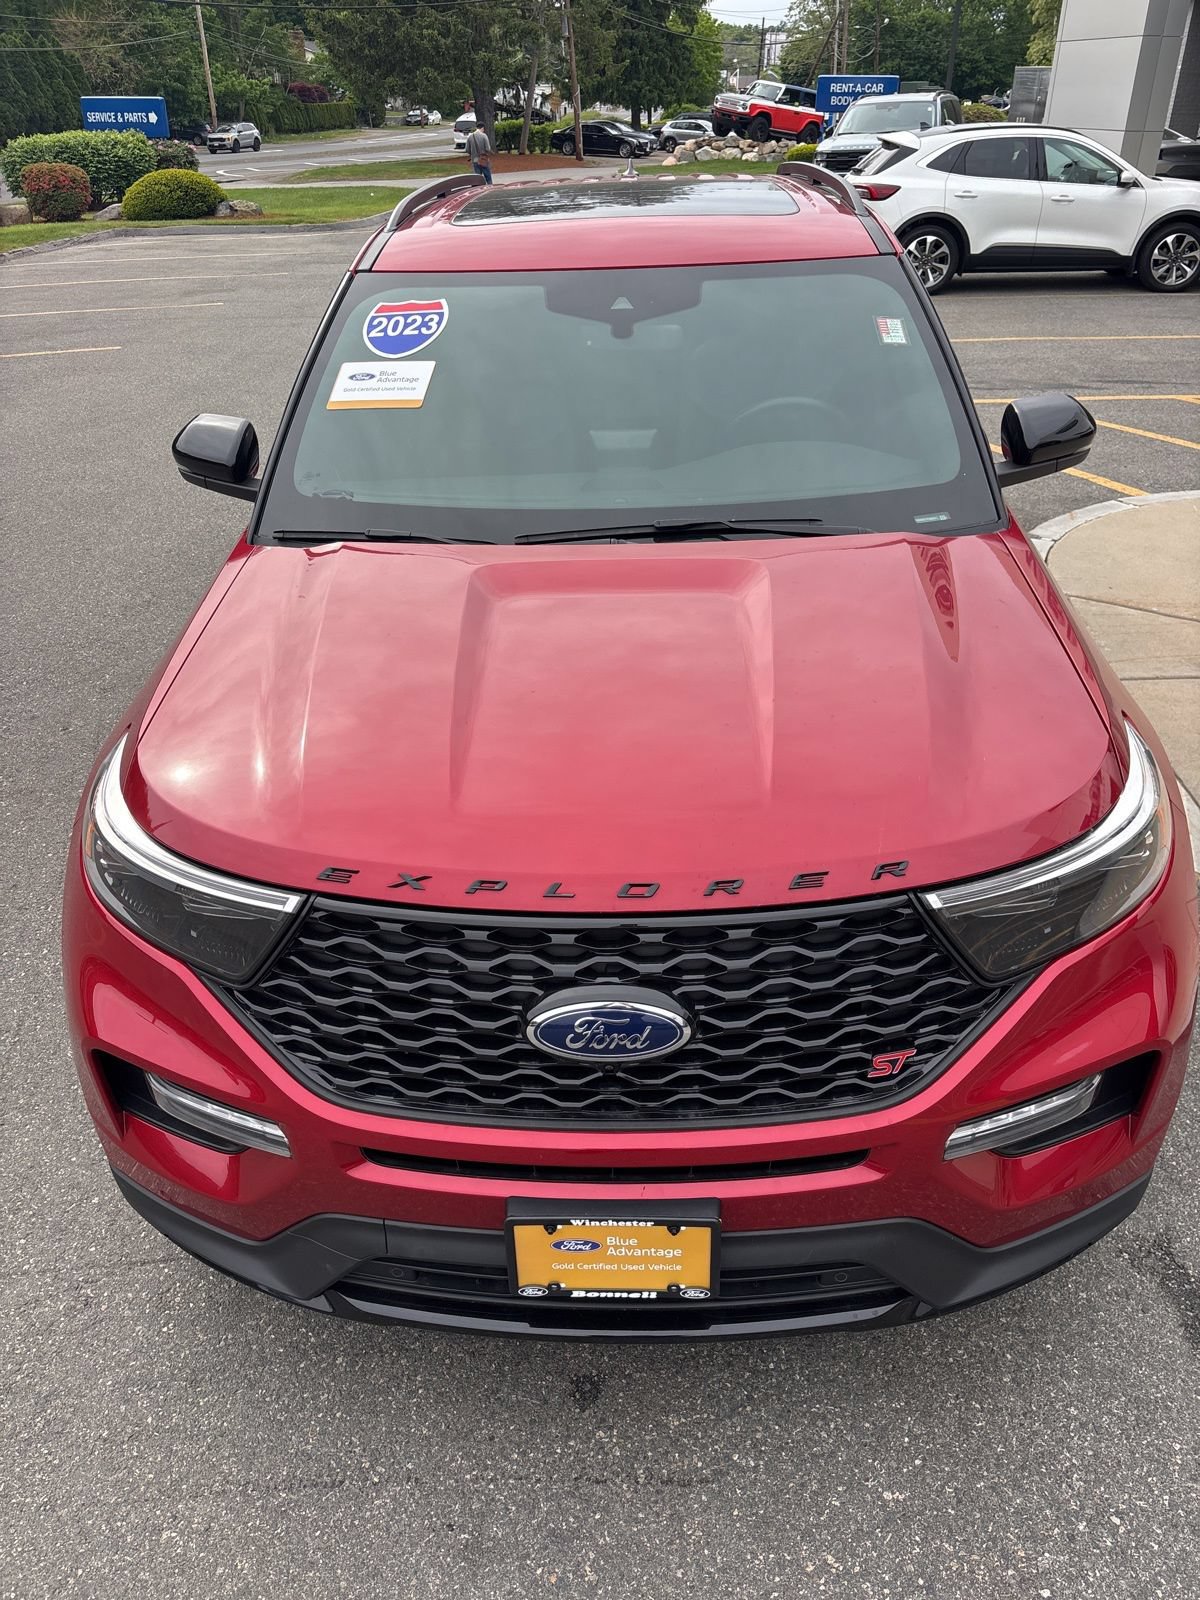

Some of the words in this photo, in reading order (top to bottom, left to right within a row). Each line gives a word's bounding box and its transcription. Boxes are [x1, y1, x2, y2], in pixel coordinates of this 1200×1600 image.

[830, 83, 884, 93] RENT-A-CAR
[830, 96, 854, 105] BODY
[86, 111, 116, 123] SERVICE
[117, 112, 123, 123] &
[123, 112, 147, 123] PARTS
[368, 313, 440, 338] 2023
[316, 860, 909, 898] EXPLORER
[565, 1016, 652, 1050] Ford
[867, 1048, 917, 1078] ST
[570, 1219, 655, 1227] Winchester
[560, 1240, 593, 1251] Ford
[606, 1236, 638, 1246] Blue
[606, 1246, 682, 1258] Advantage
[551, 1262, 575, 1271] Gold
[577, 1262, 618, 1271] Certified
[620, 1263, 645, 1271] Used
[648, 1263, 682, 1271] Vehicle
[570, 1290, 658, 1299] Bonnell
